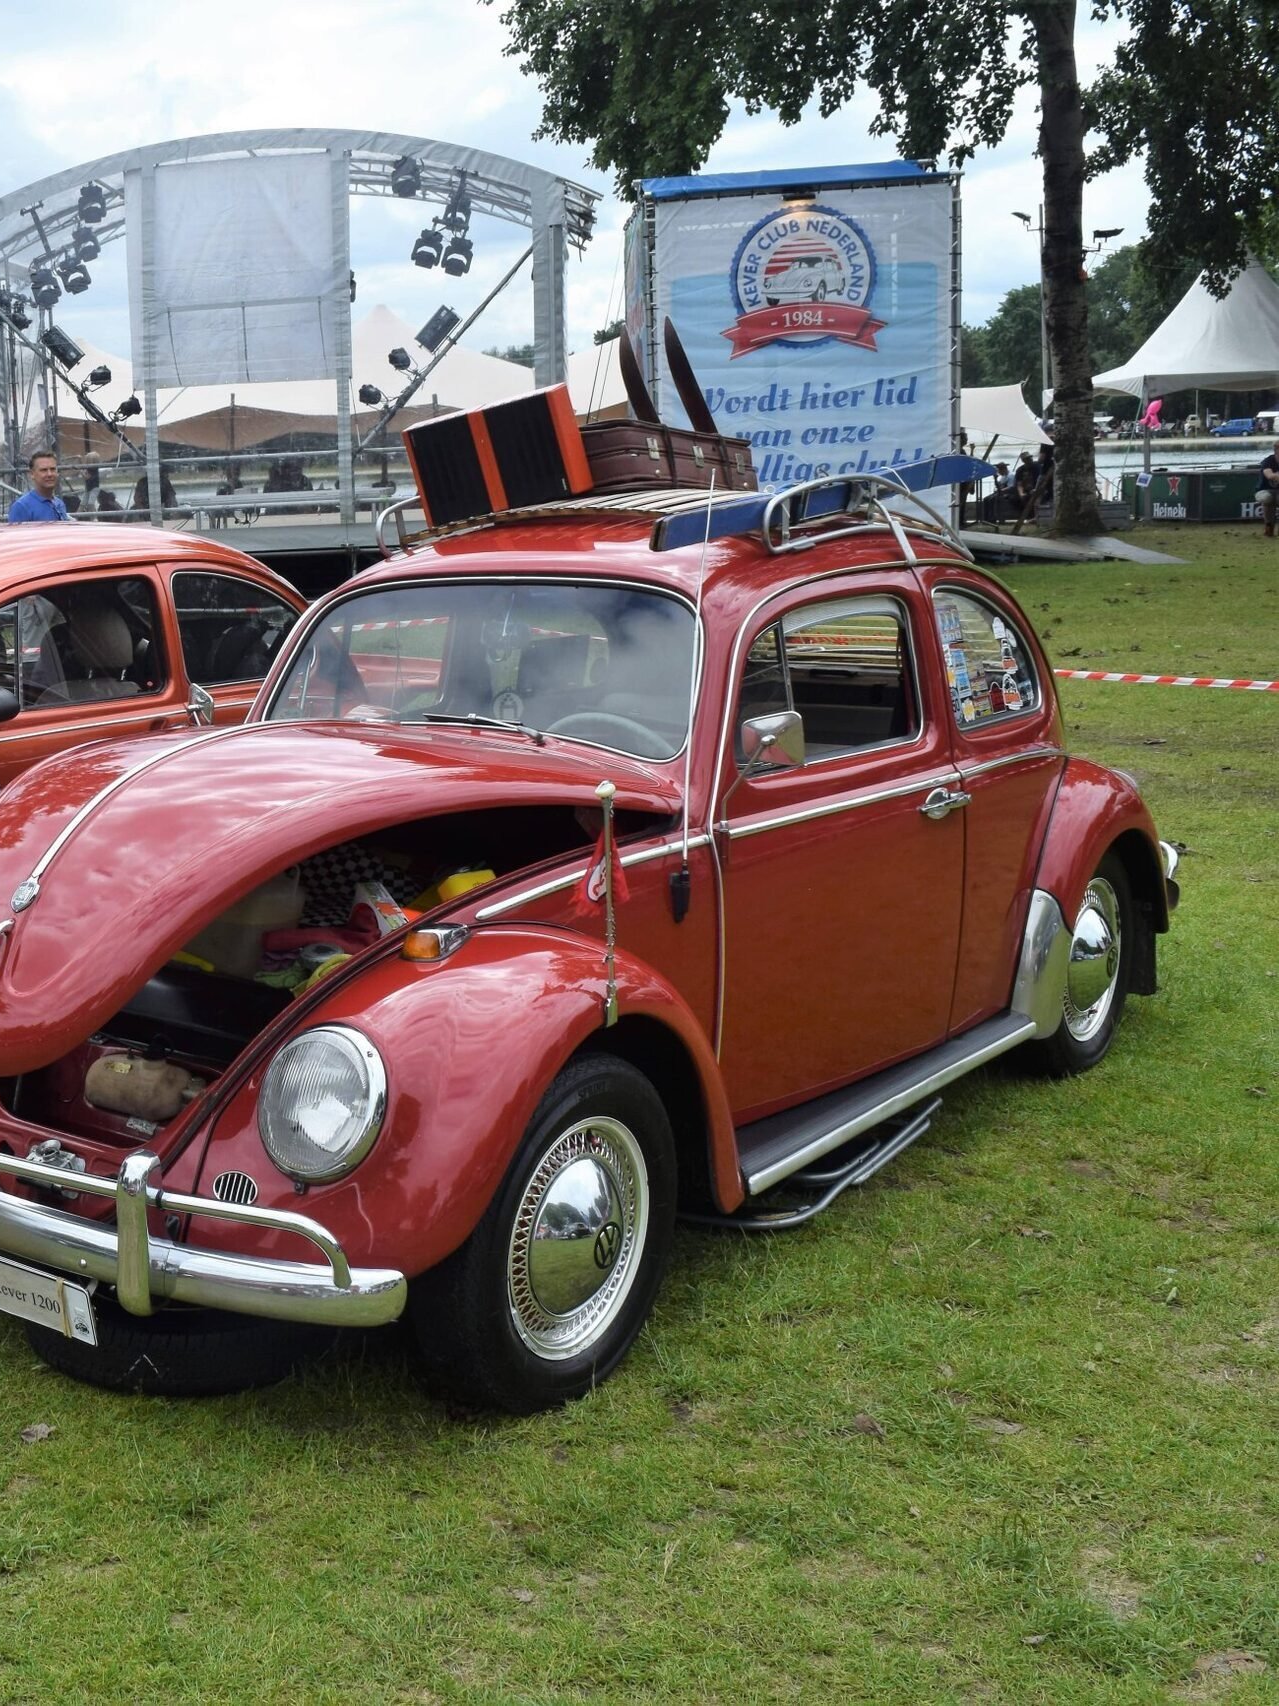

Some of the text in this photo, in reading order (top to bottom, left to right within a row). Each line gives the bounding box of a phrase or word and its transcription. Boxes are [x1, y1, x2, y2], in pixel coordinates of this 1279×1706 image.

[742, 220, 866, 307] KEVER CLUB NEDERLAND
[782, 311, 823, 328] 1984
[799, 382, 866, 410] hier
[873, 376, 918, 406] lid
[801, 424, 875, 445] onze
[32, 1292, 61, 1314] 1200
